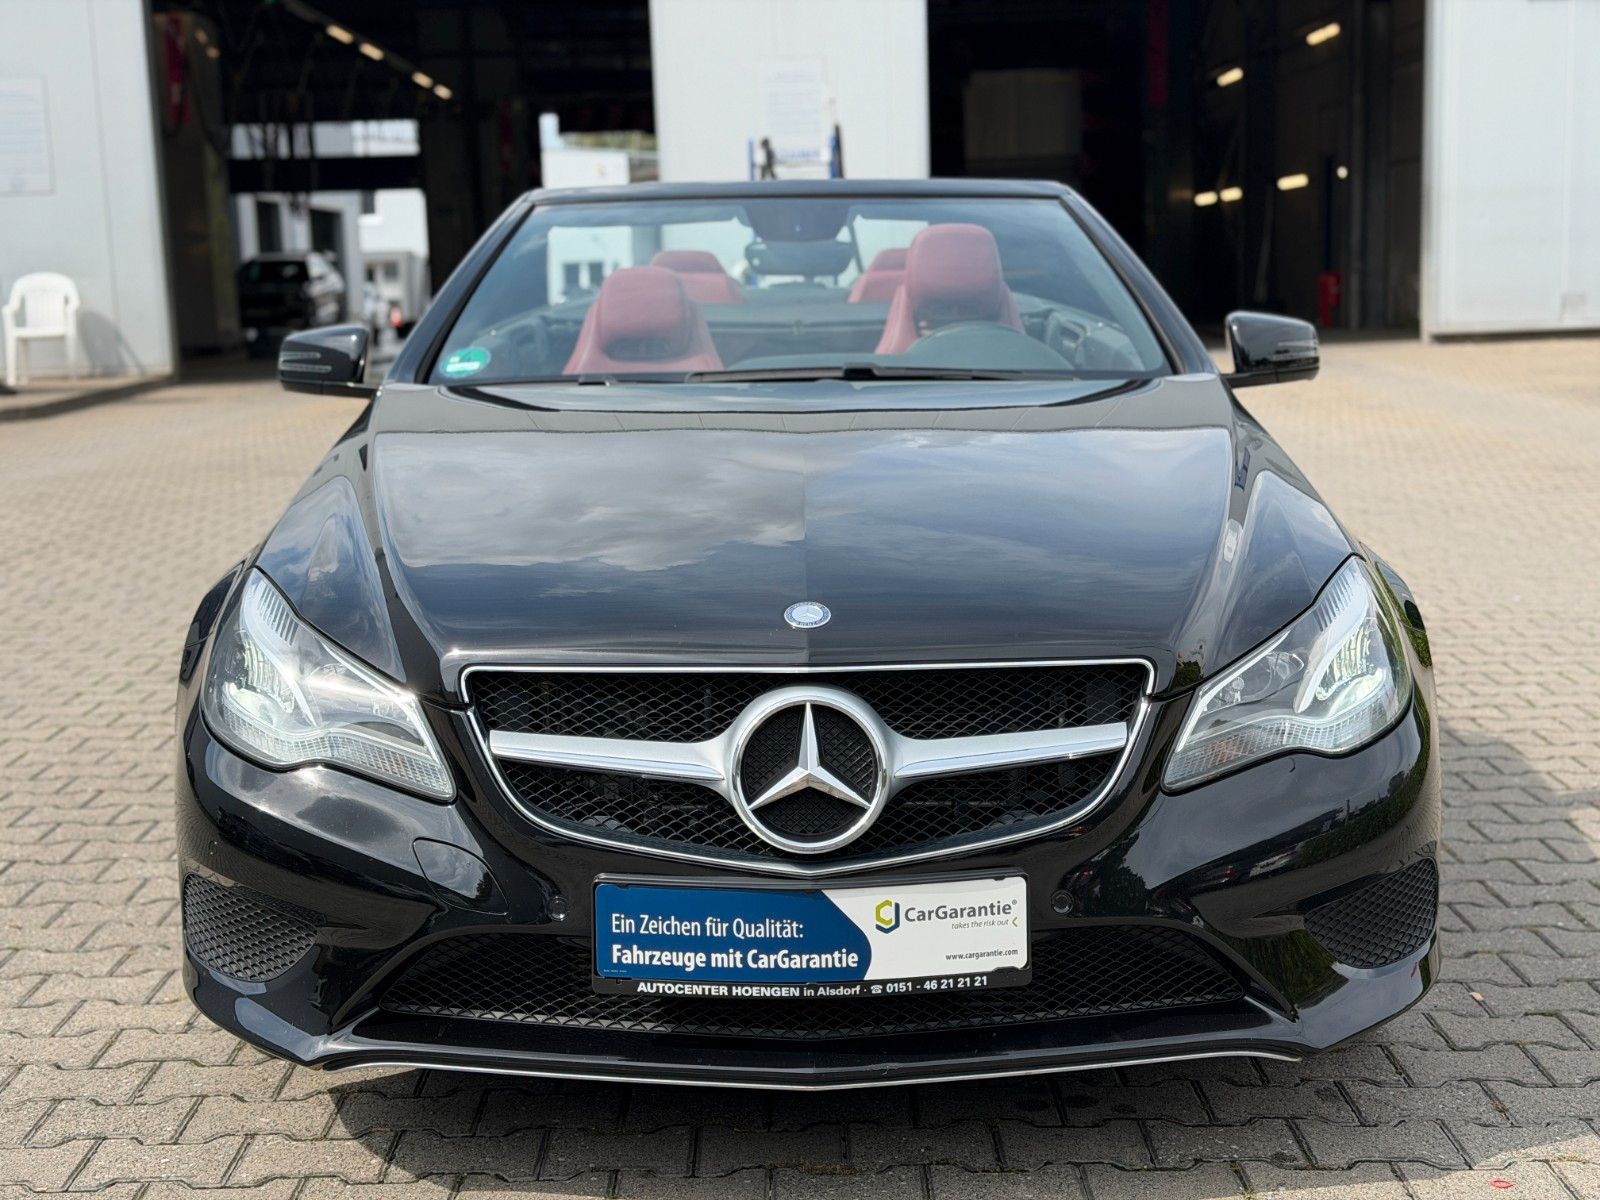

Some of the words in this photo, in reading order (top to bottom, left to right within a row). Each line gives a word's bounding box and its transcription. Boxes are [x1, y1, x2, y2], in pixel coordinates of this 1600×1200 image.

[611, 913, 635, 934] Ein
[640, 914, 701, 936] Zeichen
[705, 916, 729, 937] für
[732, 917, 804, 940] Qualität:
[951, 921, 970, 930] takes
[971, 920, 984, 928] the
[984, 919, 996, 927] risk
[612, 944, 707, 972] Fahrzeuge
[711, 948, 743, 968] mit
[747, 948, 859, 969] CarGarantie
[945, 948, 1019, 961] www.cargarantie.com
[637, 982, 728, 996] AUTOCENTER
[732, 986, 800, 997] HOENGEN
[803, 987, 815, 997] in
[817, 985, 861, 997] Alsdorf
[886, 982, 913, 993] 0151
[923, 980, 938, 991] 46
[940, 978, 953, 989] 21
[957, 977, 970, 988] 21
[974, 976, 988, 986] 21
